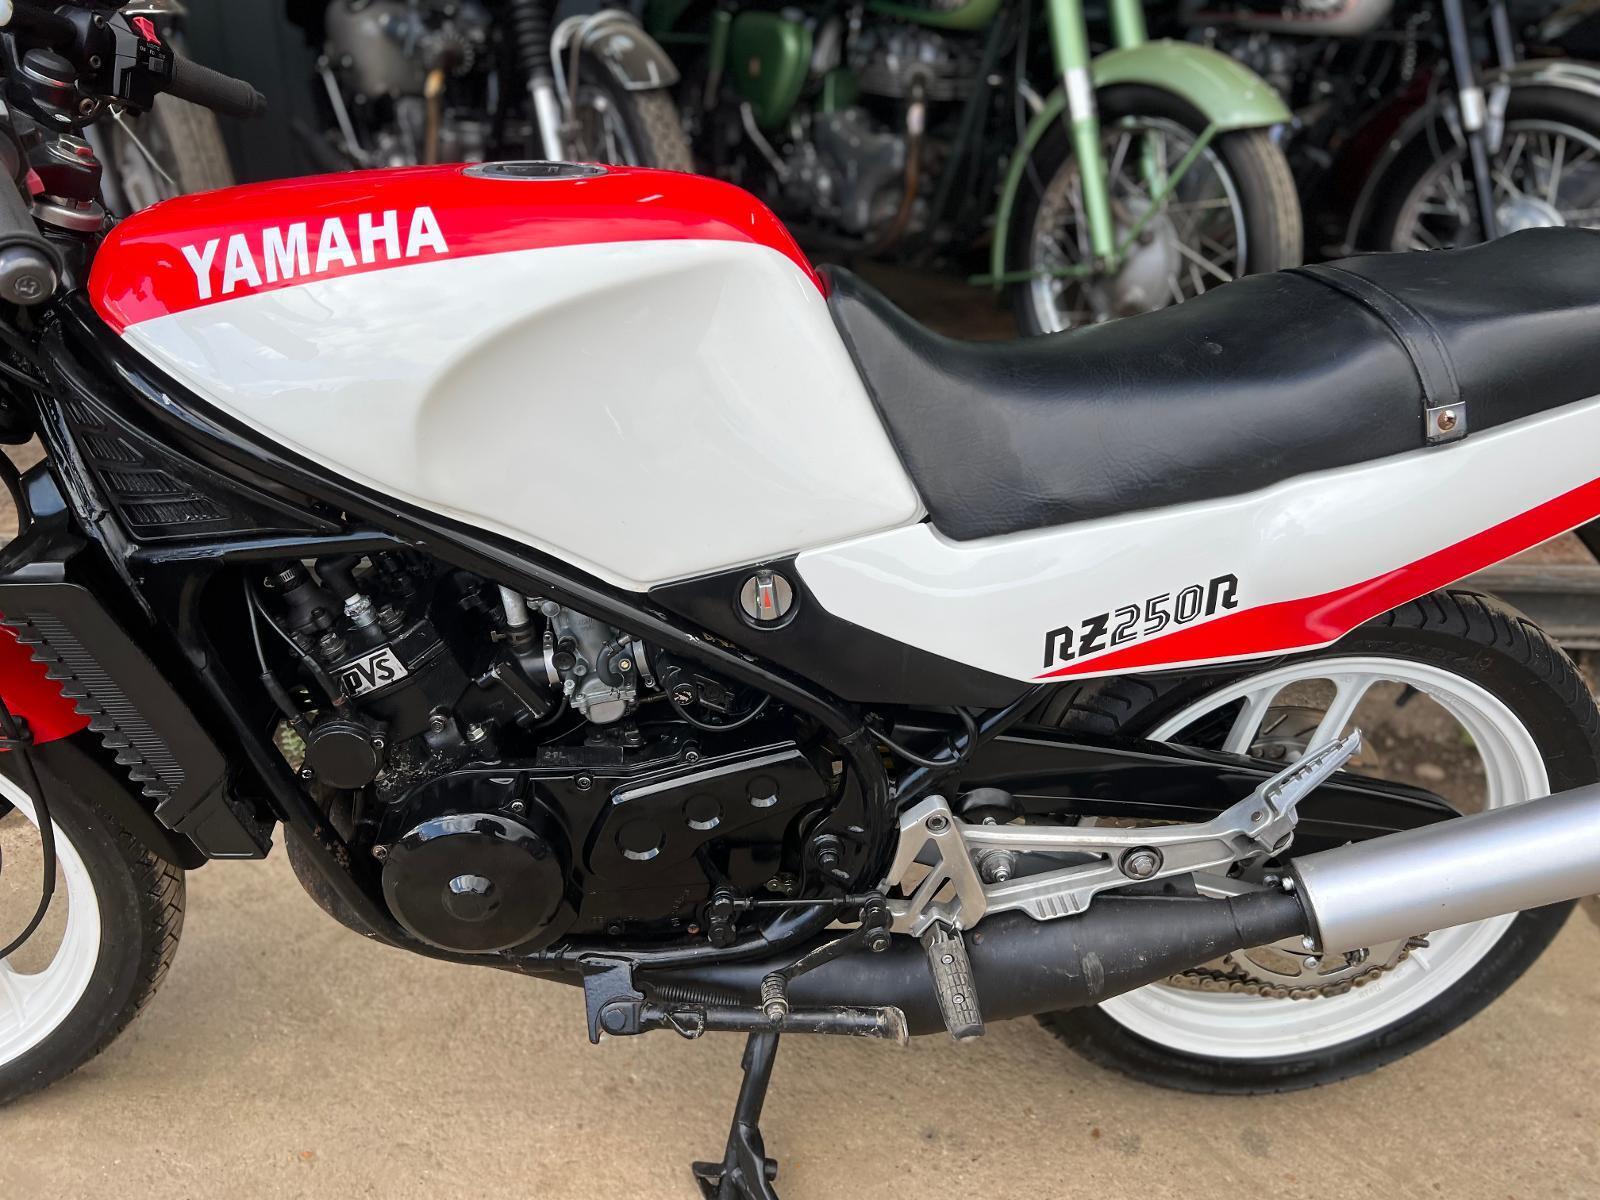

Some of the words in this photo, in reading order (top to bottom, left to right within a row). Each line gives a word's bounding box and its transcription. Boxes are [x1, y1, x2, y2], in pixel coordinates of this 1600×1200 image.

[181, 205, 450, 300] YAMAHA
[1043, 573, 1239, 669] RZ250R
[338, 650, 396, 697] PVS
